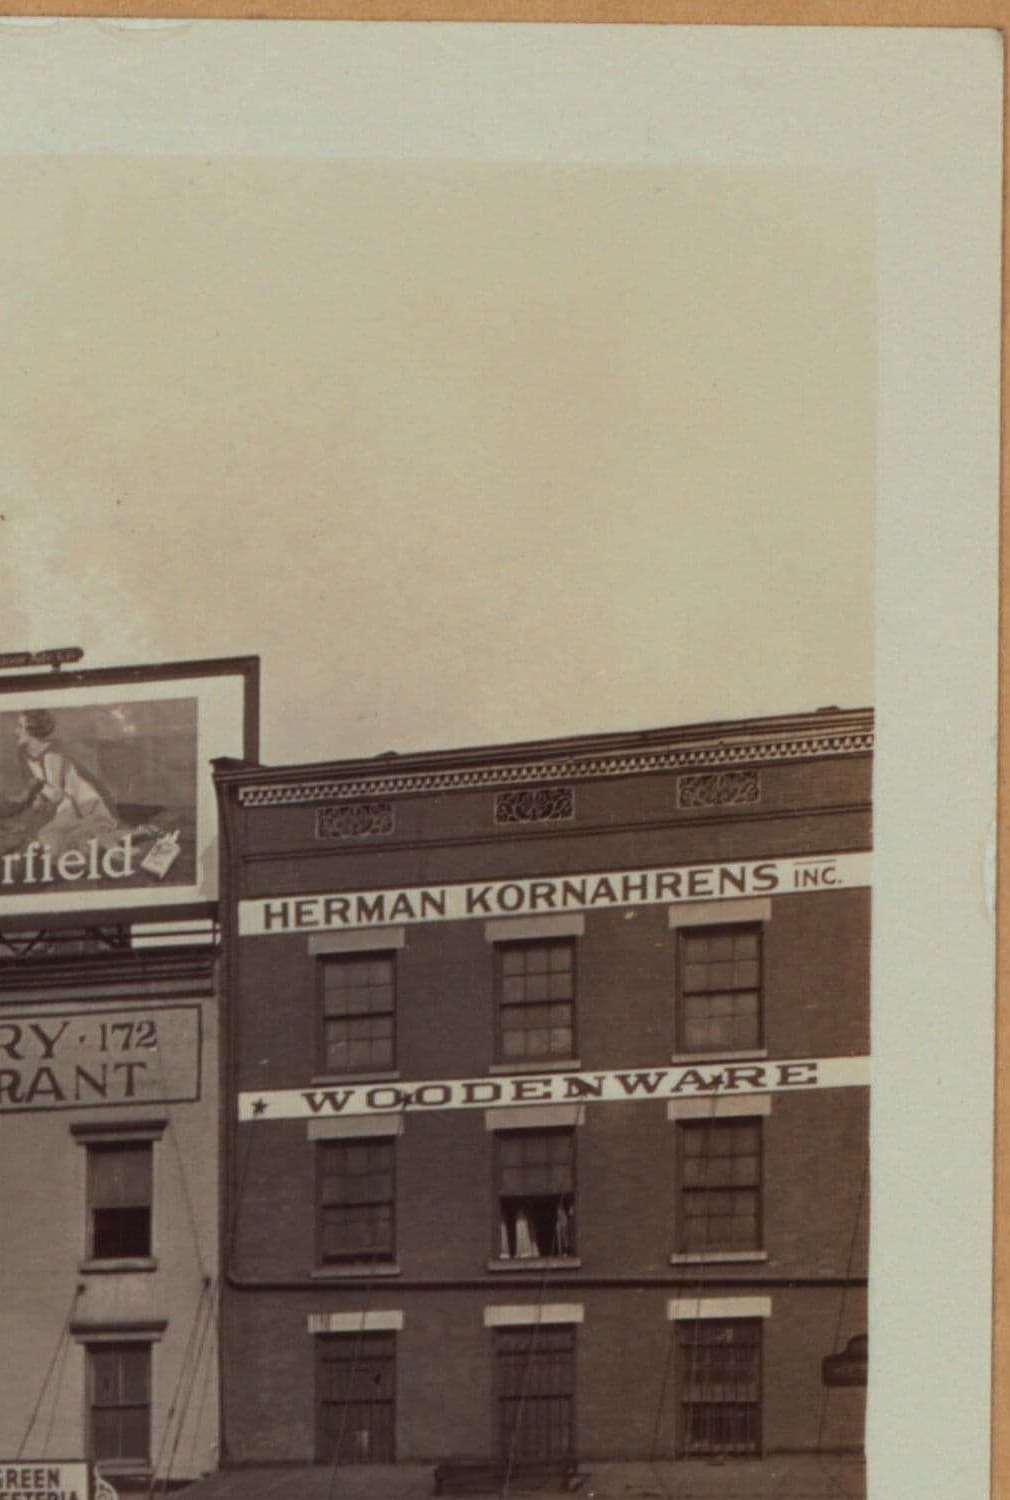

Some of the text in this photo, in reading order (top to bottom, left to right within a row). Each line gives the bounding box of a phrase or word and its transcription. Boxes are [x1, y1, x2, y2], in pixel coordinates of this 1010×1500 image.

[263, 863, 844, 930] HERMAN KORNAHRENS INC.
[99, 1020, 158, 1052] 172
[301, 1062, 818, 1113] WOODENWARE
